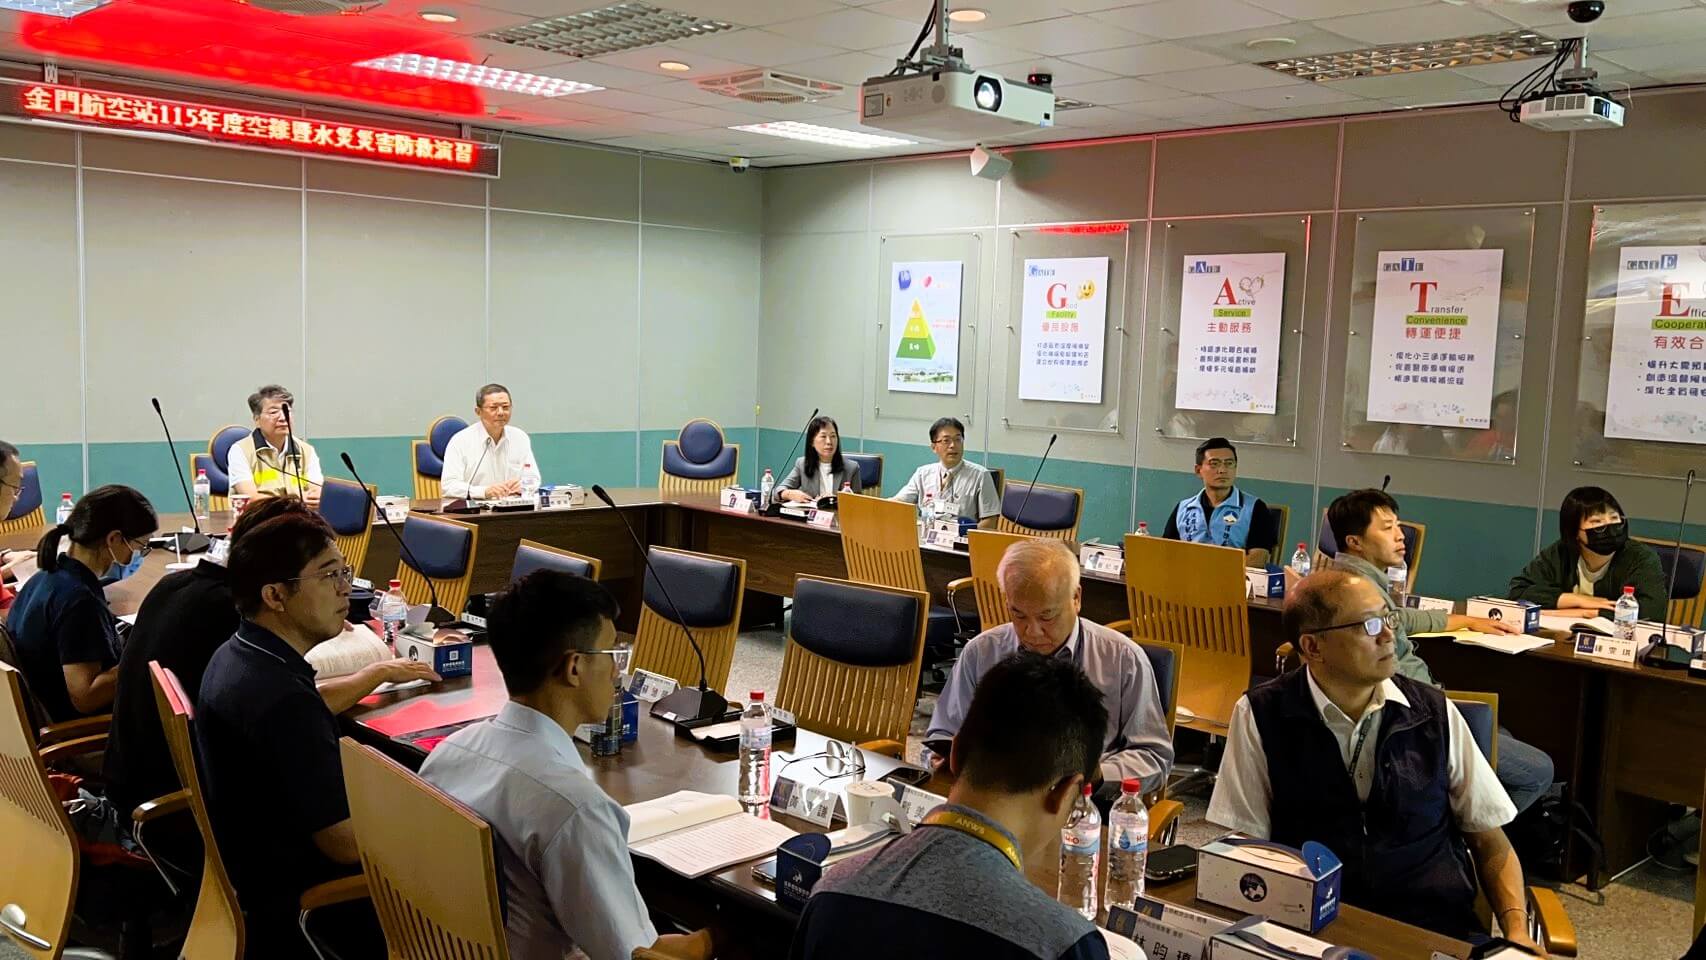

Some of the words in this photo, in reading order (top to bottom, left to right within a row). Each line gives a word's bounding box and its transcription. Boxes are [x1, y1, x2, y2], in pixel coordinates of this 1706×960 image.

[1410, 281, 1464, 313] Transfer
[1217, 309, 1247, 317] Service
[1406, 315, 1467, 325] Convenience
[1207, 322, 1252, 333] 主動服務
[1406, 327, 1461, 340] 轉運便捷
[955, 818, 986, 835] ANWS
